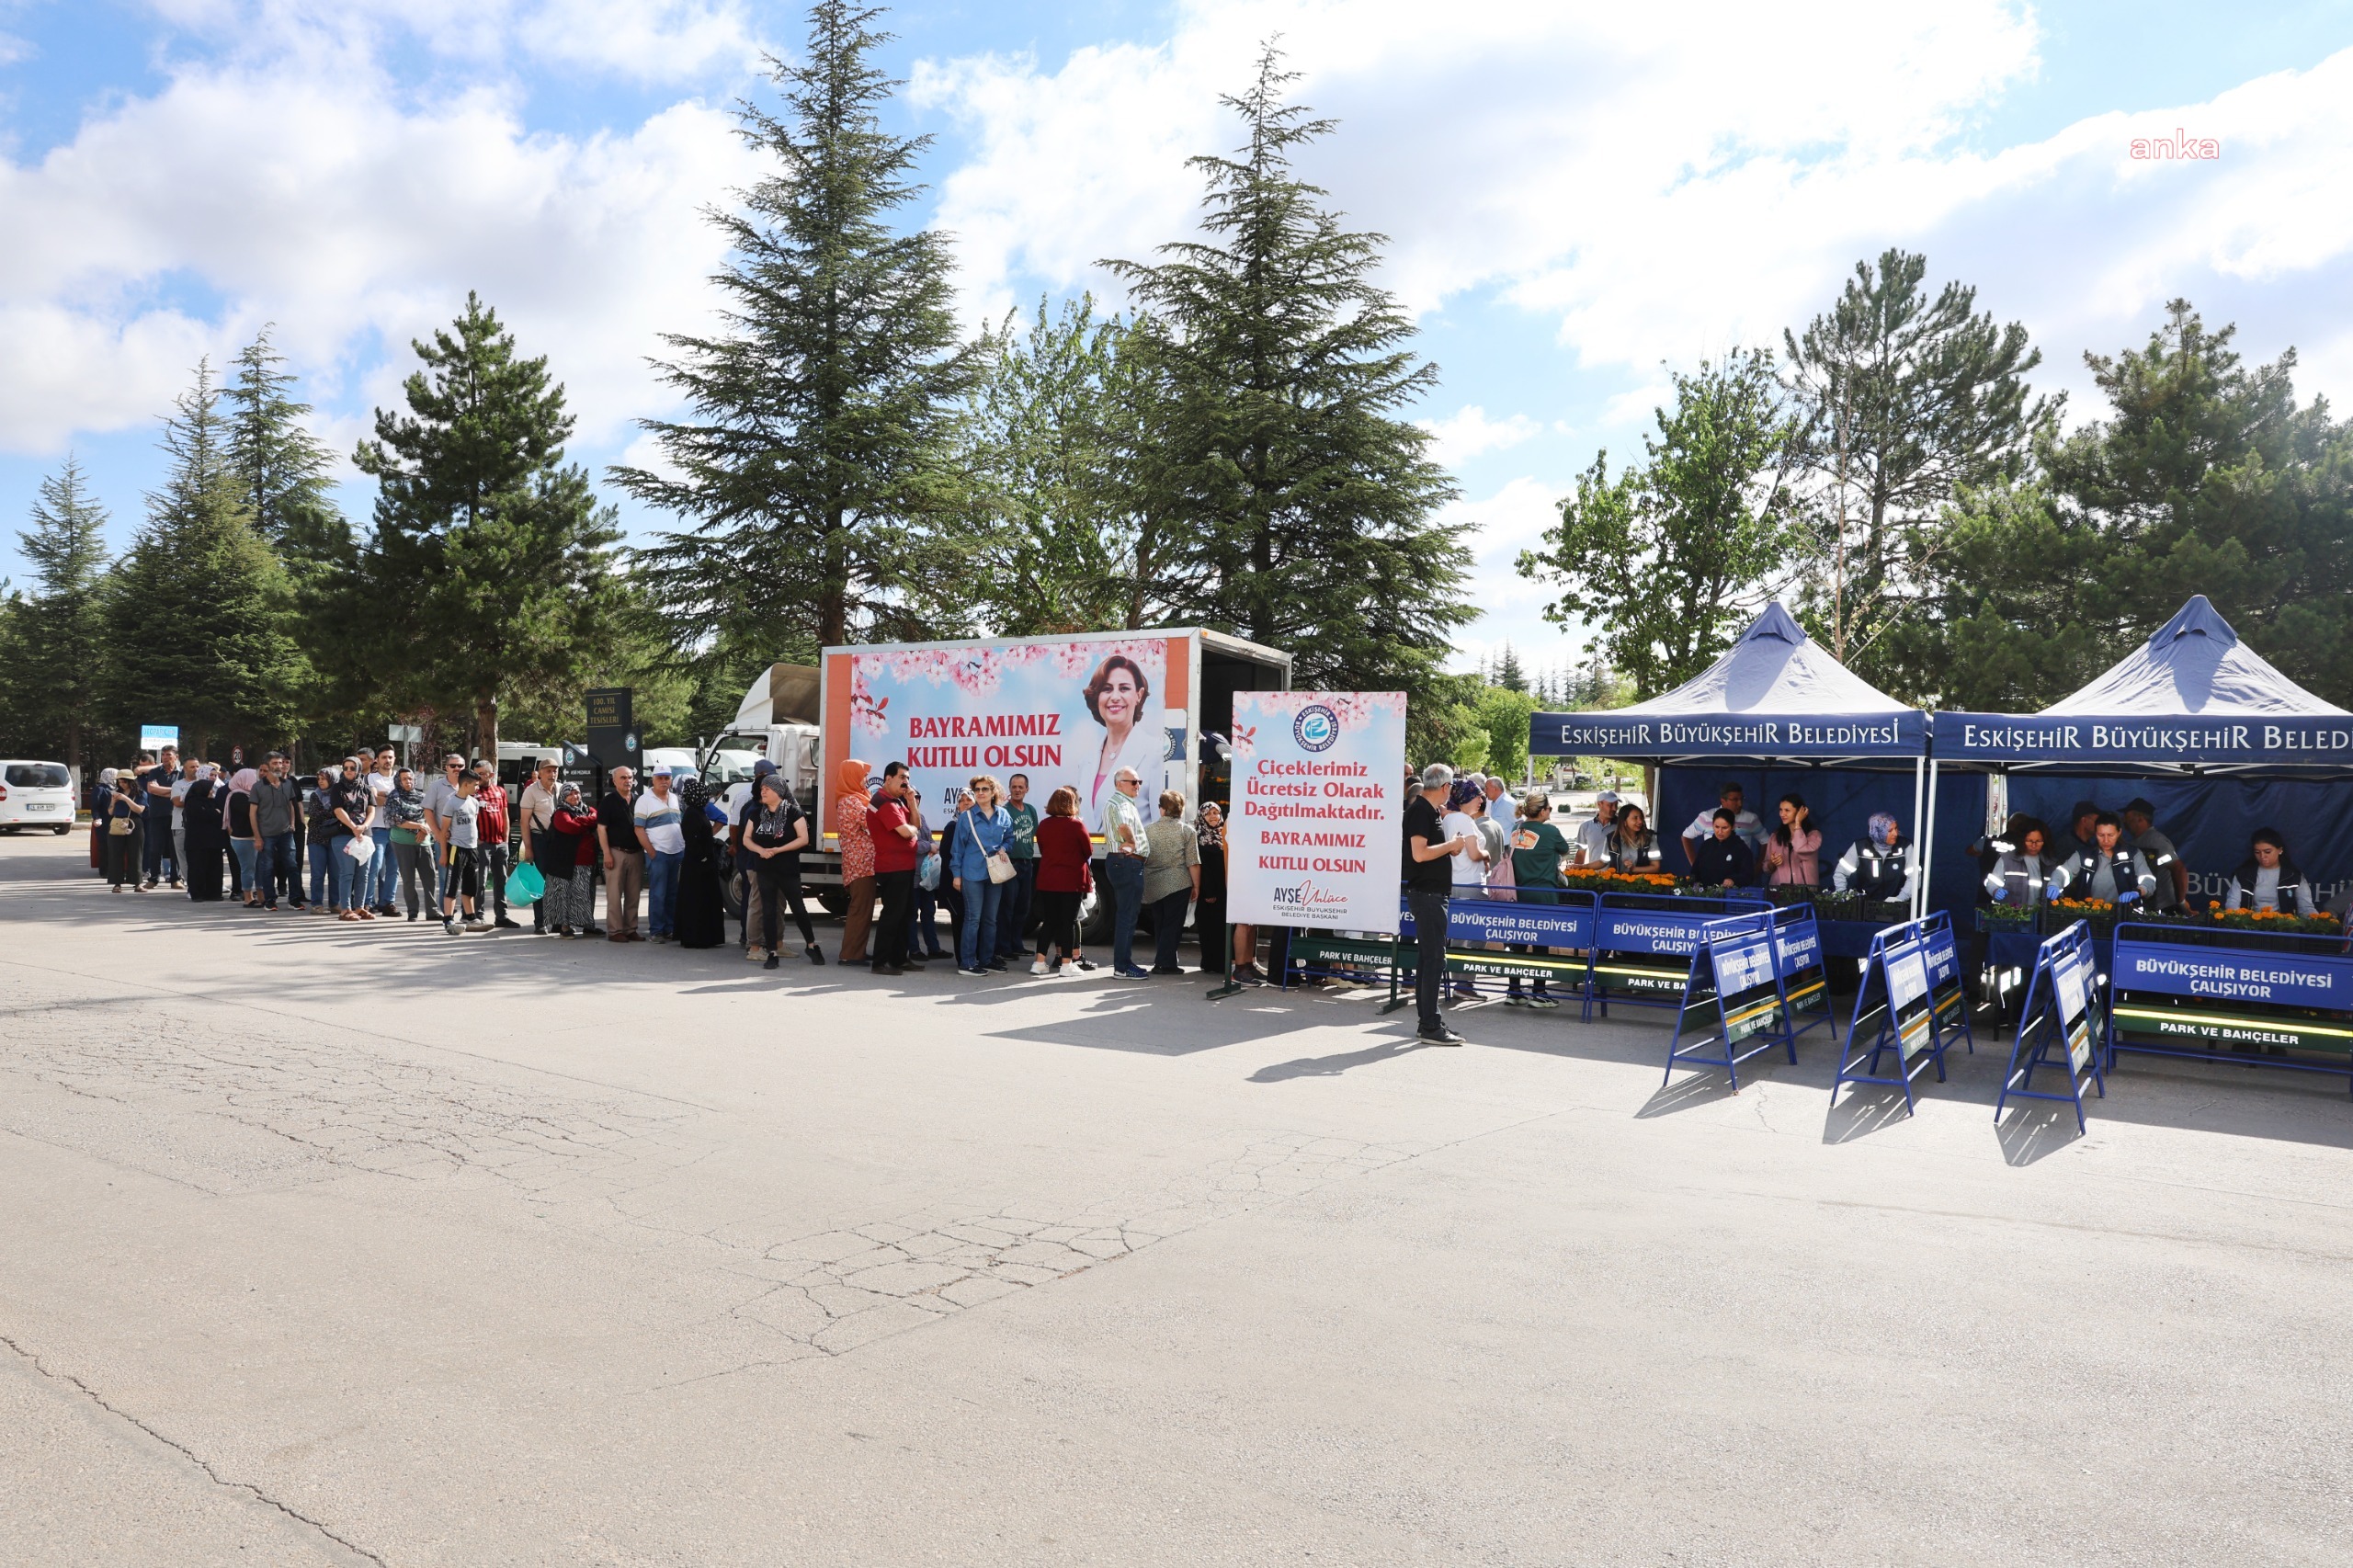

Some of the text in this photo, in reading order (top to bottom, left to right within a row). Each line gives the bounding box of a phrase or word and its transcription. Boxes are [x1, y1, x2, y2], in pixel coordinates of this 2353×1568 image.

[593, 706, 615, 714] CAMİSİ
[1302, 706, 1331, 717] ESKİŞEHİR
[590, 715, 619, 724] TESİSLERİ
[909, 713, 1062, 738] BAYRAMIMIZ
[1294, 721, 1337, 752] BÜYÜKŞEHİR BELEDİYESİ
[907, 744, 1062, 767] KUTLU OLSUN
[1256, 759, 1368, 778] Çiçeklerimiz
[1246, 776, 1384, 799] Ücretsiz Olarak
[1245, 801, 1385, 821] Dağıtılmaktadır.
[1260, 831, 1366, 847] BAYRAMIMIZ
[1258, 856, 1366, 873] KUTLU OLSUN
[1273, 887, 1302, 903] AYŞE
[1451, 912, 1577, 933] BÜYÜKŞEHİR BELEDİYESİ
[1613, 922, 1686, 938] BÜYÜKŞEHİR
[1485, 928, 1538, 942] ÇALIŞIYOR
[1652, 939, 1697, 953] ÇALIŞIY
[1319, 950, 1392, 965] PARK VE BAHÇELER
[1463, 963, 1553, 979] PARK VE BAHÇELER
[2136, 958, 2333, 989] BÜYÜKŞEHİR BELEDİYESİ
[1628, 978, 1654, 988] PARK
[1657, 981, 1671, 989] VE
[2190, 979, 2271, 998] ÇALIŞIYOR
[2160, 1022, 2300, 1045] PARK VE BAHÇELER
